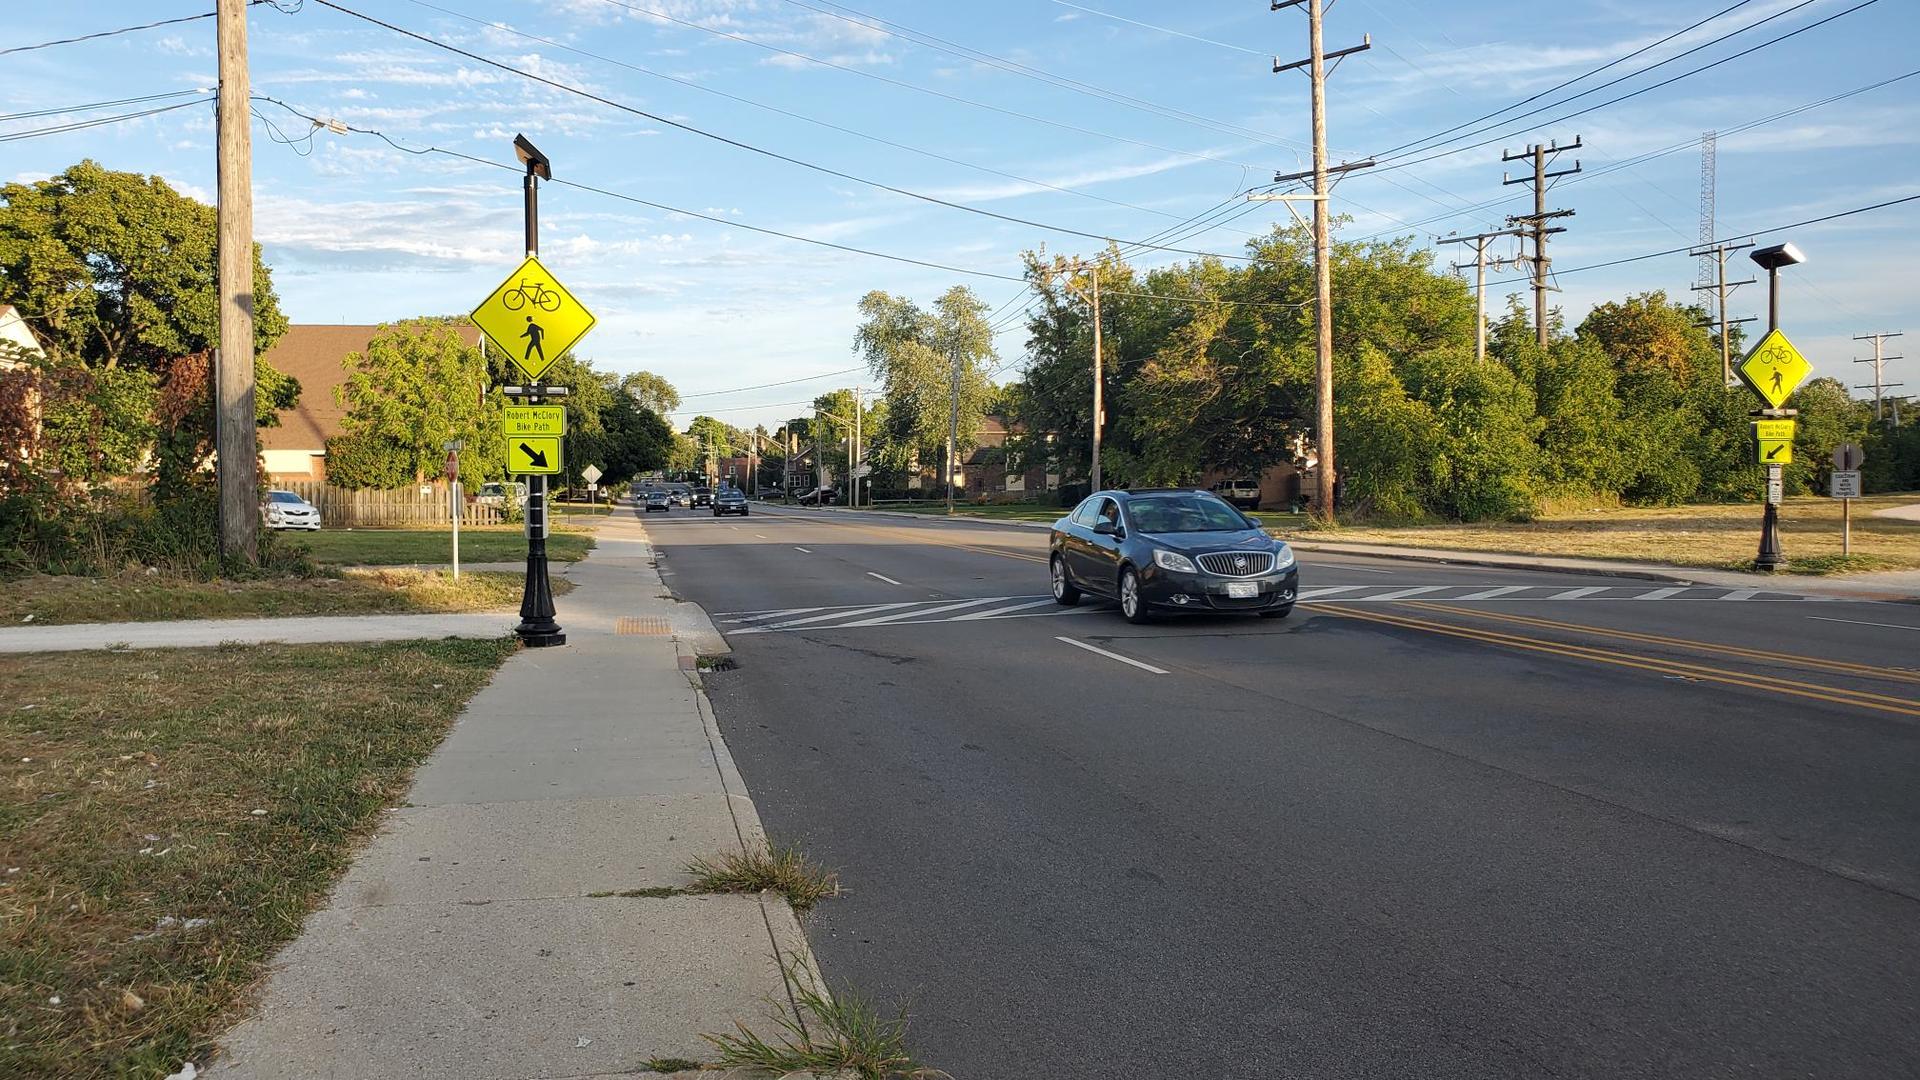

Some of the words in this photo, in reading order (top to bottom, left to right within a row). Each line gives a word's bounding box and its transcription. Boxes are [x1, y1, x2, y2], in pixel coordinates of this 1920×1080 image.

[506, 410, 530, 420] Robert
[532, 410, 560, 422] McClory
[516, 422, 531, 431] Bike
[533, 422, 550, 431] Path
